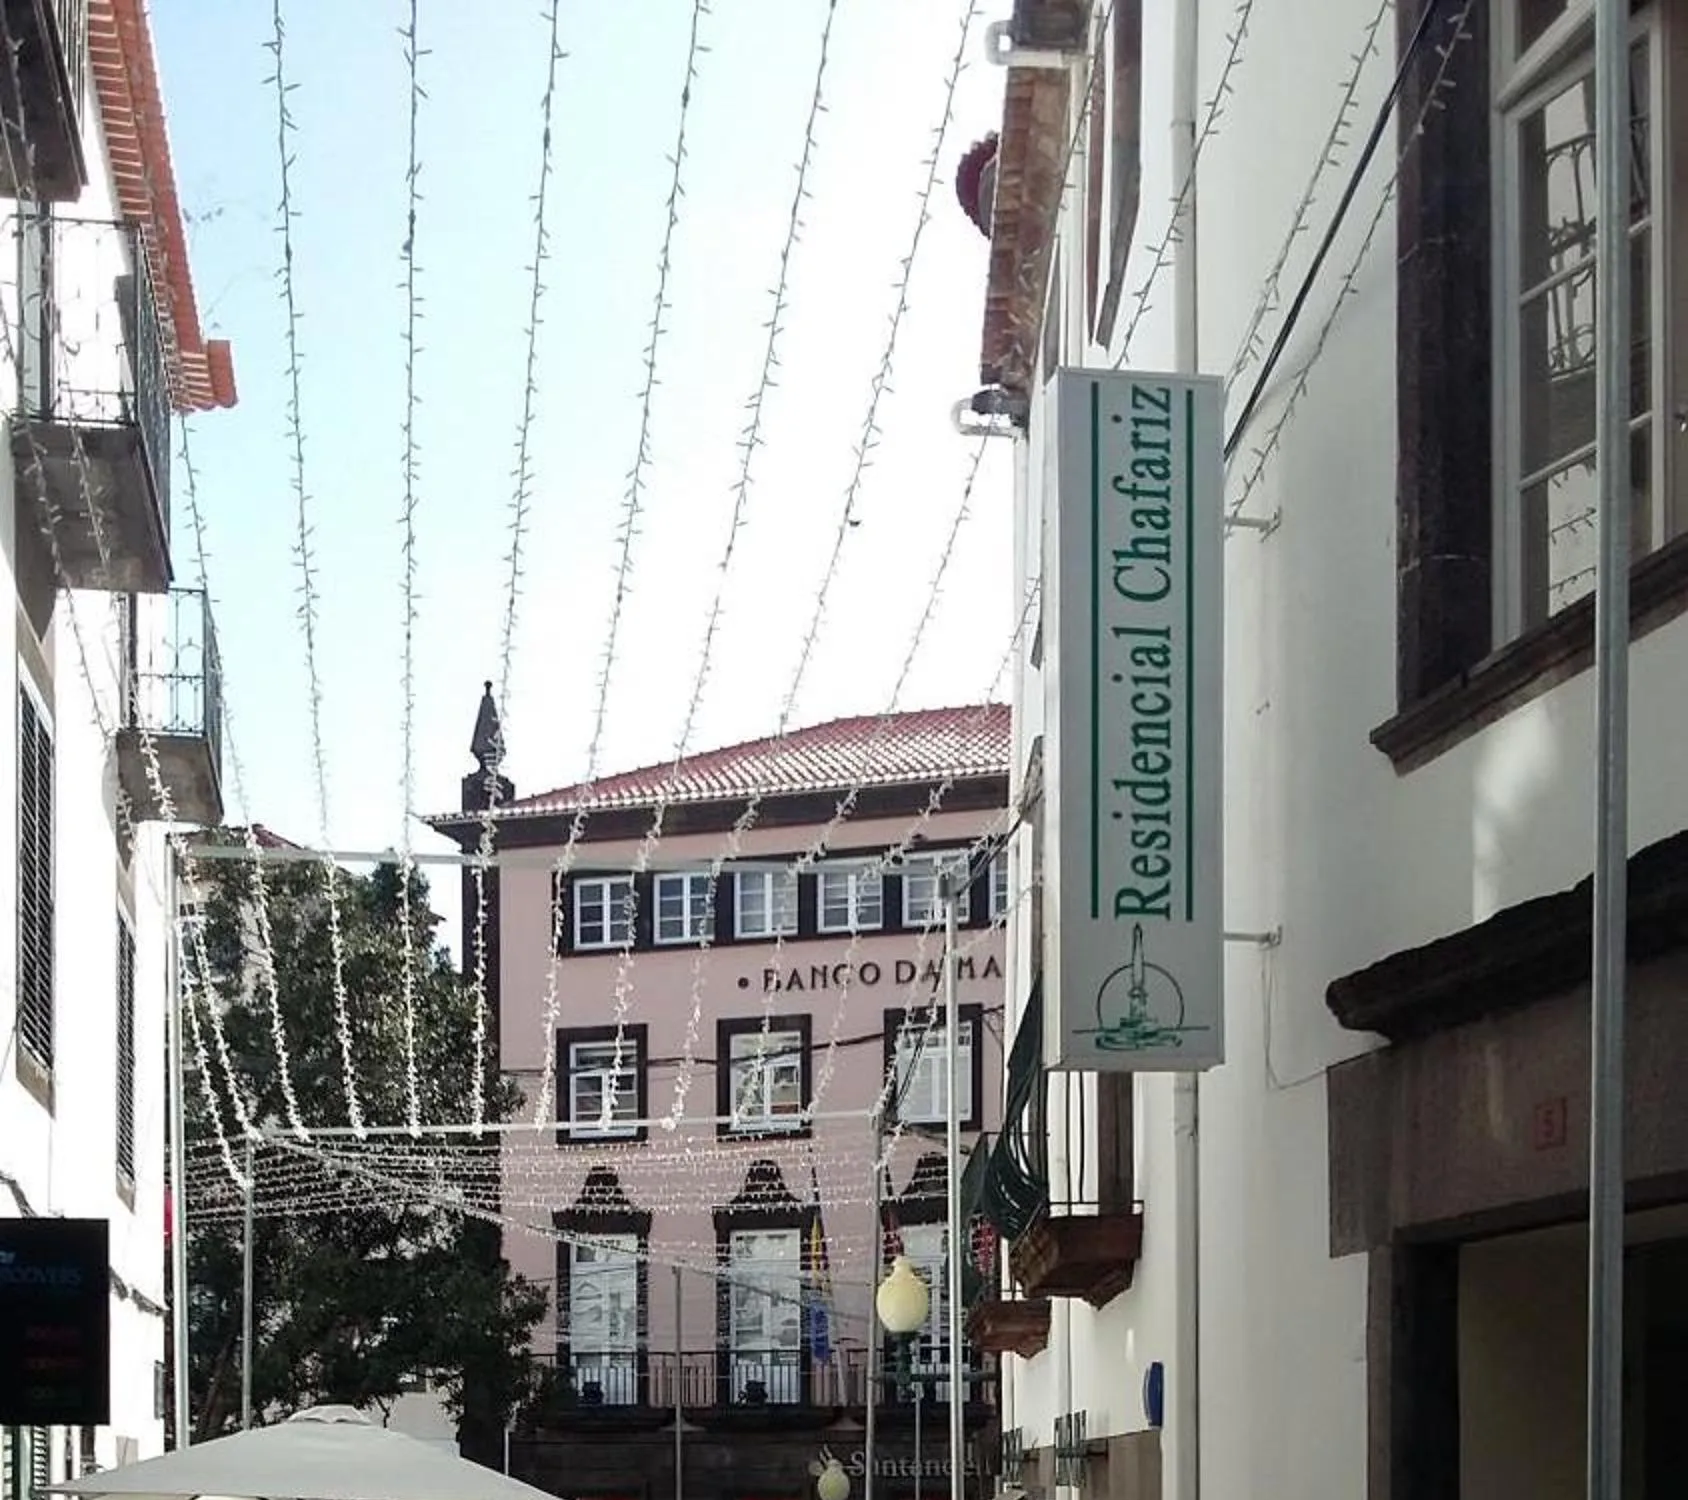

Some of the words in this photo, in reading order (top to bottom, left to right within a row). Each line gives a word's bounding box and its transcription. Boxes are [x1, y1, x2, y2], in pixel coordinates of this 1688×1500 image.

[1111, 383, 1172, 603] Chafariz
[1112, 625, 1172, 922] Residencial
[763, 962, 881, 992] BANCO
[850, 1449, 991, 1478] Sntaner
